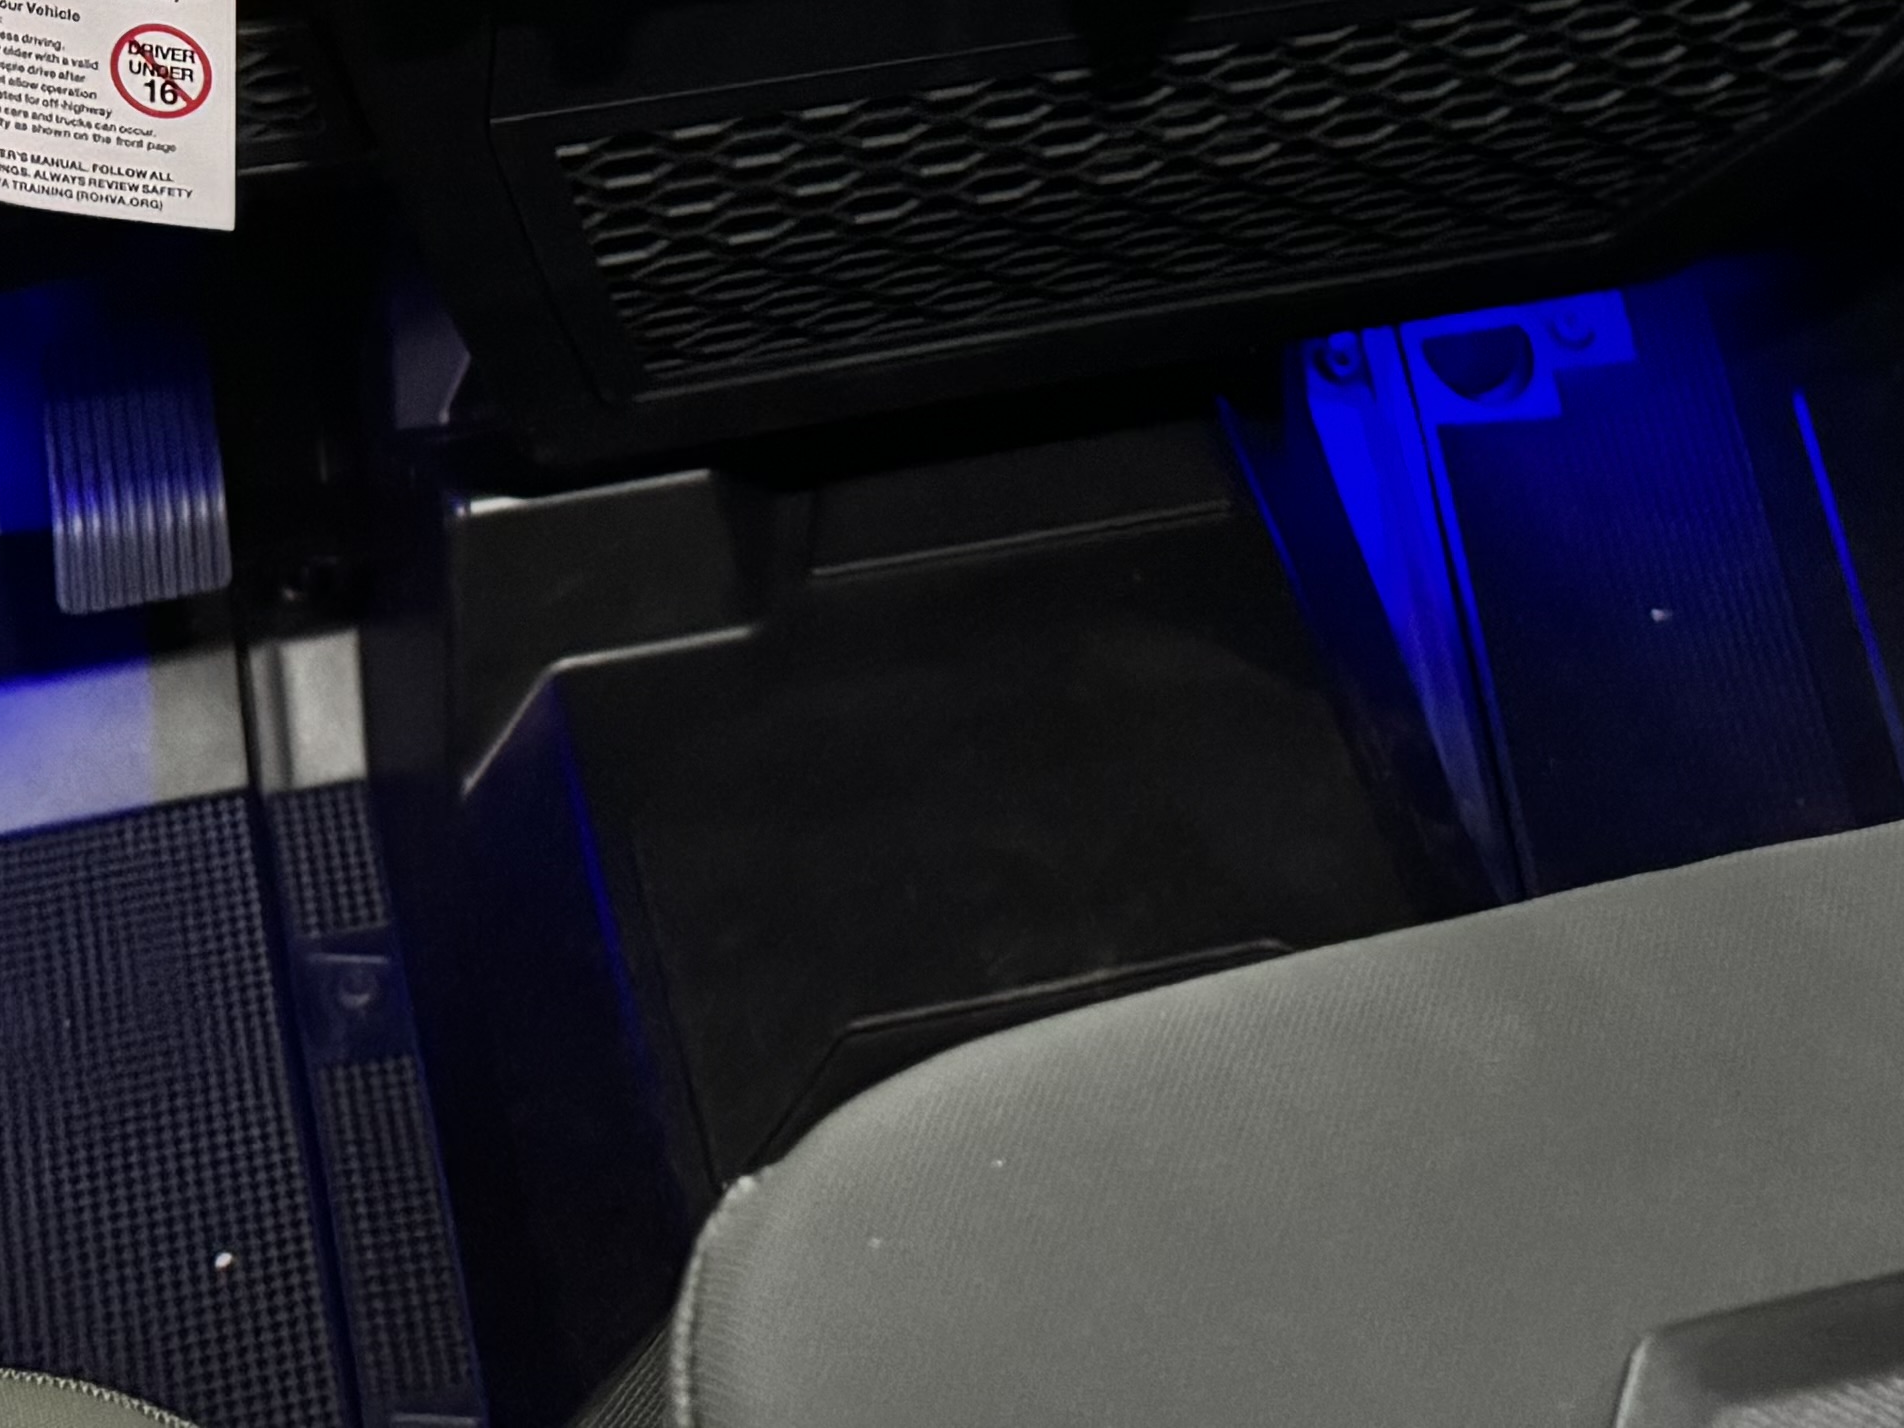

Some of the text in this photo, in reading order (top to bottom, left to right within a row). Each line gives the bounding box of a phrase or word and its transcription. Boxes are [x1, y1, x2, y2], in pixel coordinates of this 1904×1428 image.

[27, 2, 80, 22] Vehicle
[127, 39, 196, 64] DRIVER
[128, 61, 195, 83] UNDER
[143, 78, 179, 105] 16
[34, 170, 85, 186] ALWAYS
[88, 178, 139, 192] REVIEW
[142, 185, 192, 198] SAFETY
[92, 164, 147, 179] FOLLOW
[150, 171, 173, 182] ALL
[13, 180, 73, 198] TRAINING
